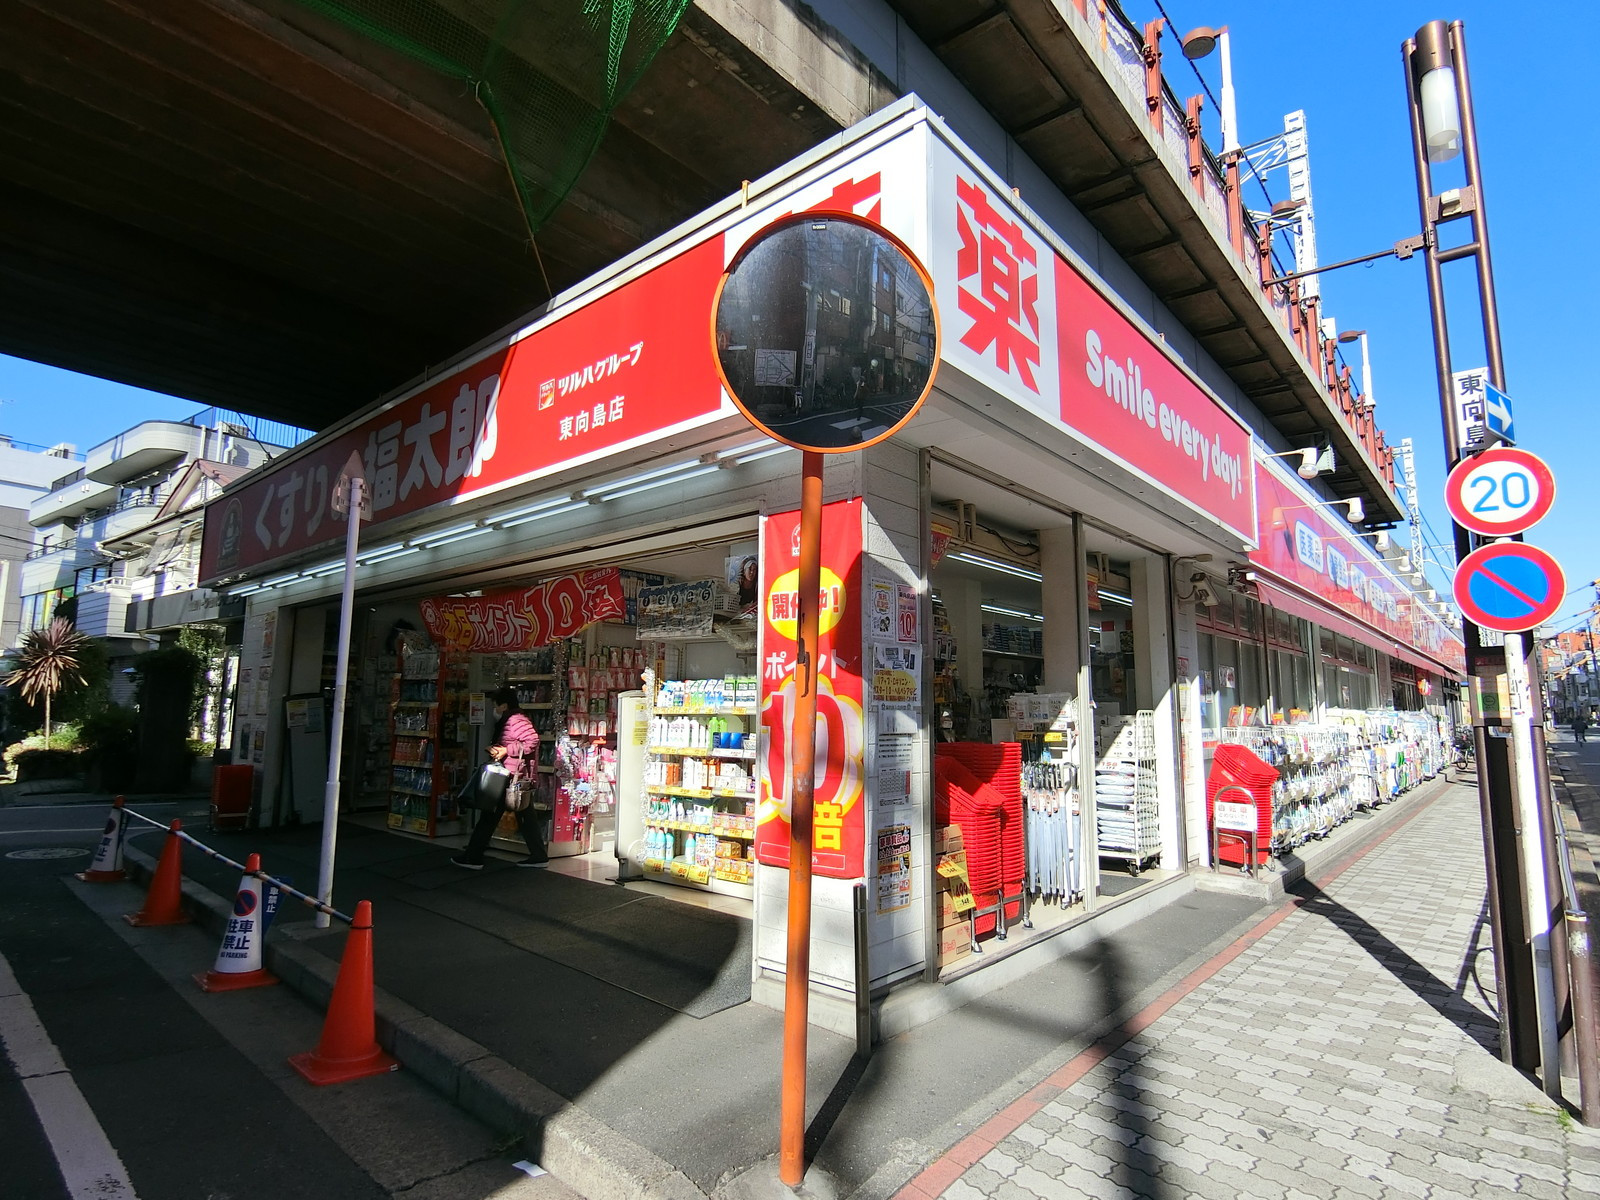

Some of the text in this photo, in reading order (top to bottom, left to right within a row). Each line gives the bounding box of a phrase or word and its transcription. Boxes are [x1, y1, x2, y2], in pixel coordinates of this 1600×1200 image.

[957, 174, 1041, 396] 薬
[558, 340, 644, 397] ツルハグループ
[559, 395, 625, 441] 東向島店
[1085, 329, 1242, 501] Smile every day!
[1458, 373, 1486, 454] 東向島
[254, 372, 501, 551] くすり福太郎
[1470, 471, 1530, 513] 20
[266, 885, 280, 913] 車禁止
[222, 935, 251, 950] 禁止
[228, 919, 254, 934] 駐車
[226, 951, 248, 959] PARKING
